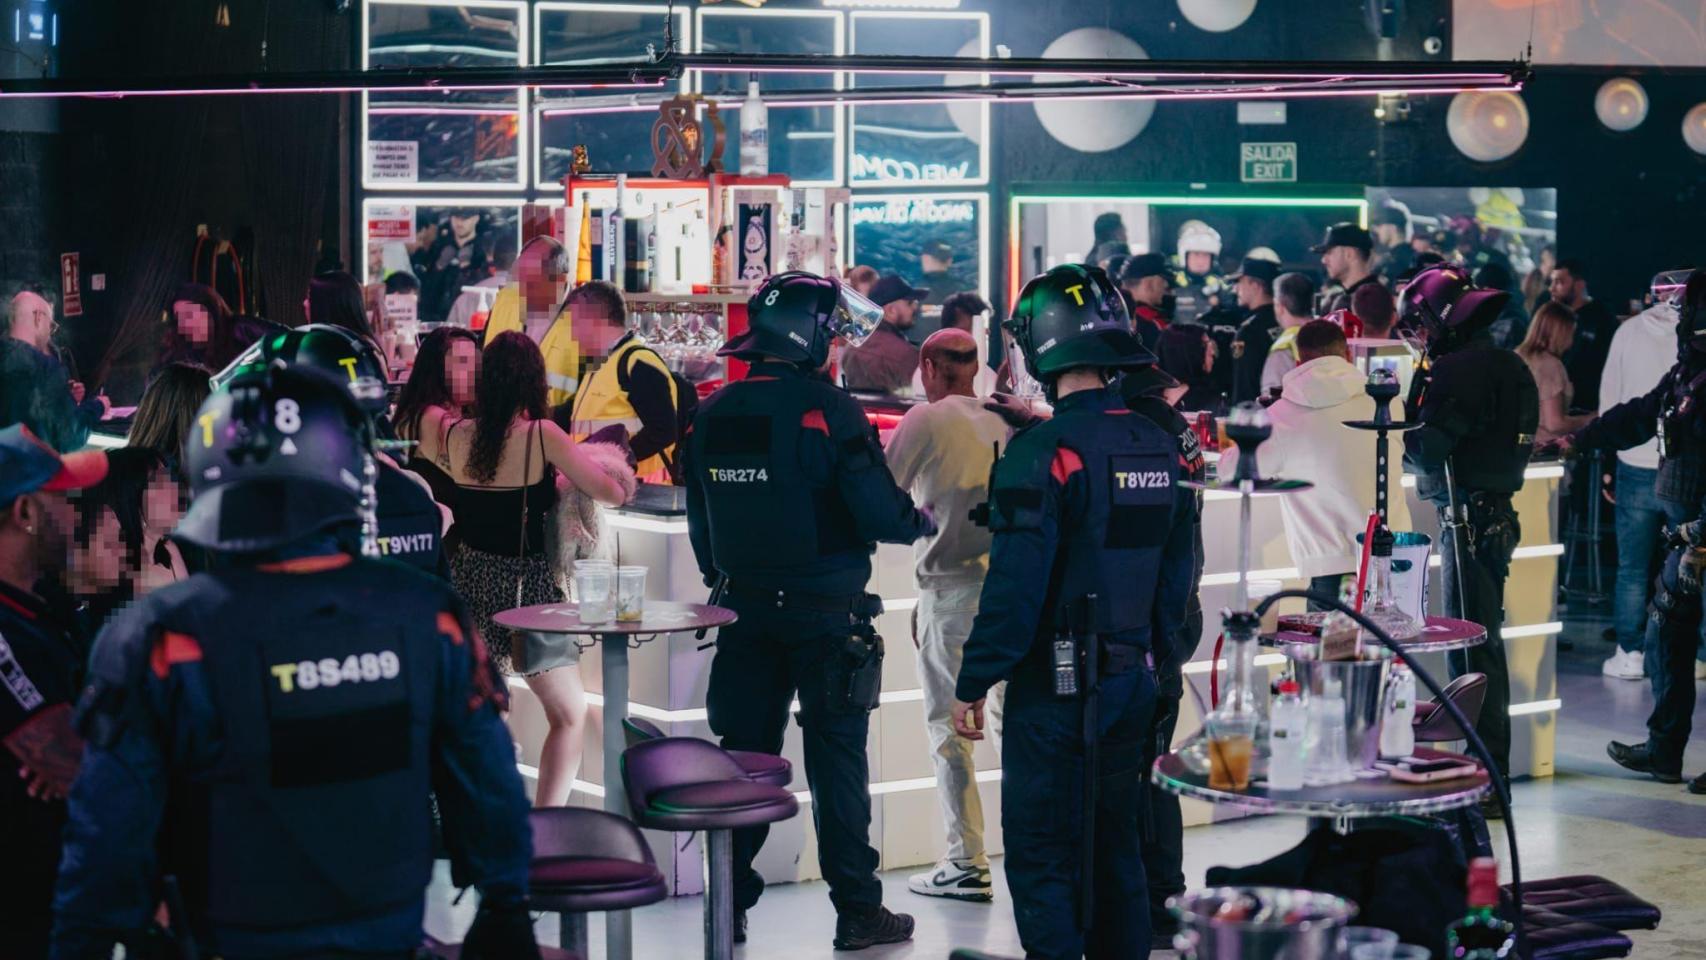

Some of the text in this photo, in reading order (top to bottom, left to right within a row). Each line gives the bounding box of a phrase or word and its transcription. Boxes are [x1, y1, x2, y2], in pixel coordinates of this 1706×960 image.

[1243, 144, 1296, 161] SALIDA
[1253, 163, 1286, 178] EXIT
[764, 289, 780, 306] 8
[1065, 284, 1085, 306] T
[338, 357, 358, 383] T
[274, 397, 302, 434] 8
[198, 409, 221, 448] T
[708, 468, 769, 482] T6R274
[1115, 471, 1170, 489] T8V223
[377, 533, 433, 555] T9V177
[271, 650, 400, 693] T8S489
